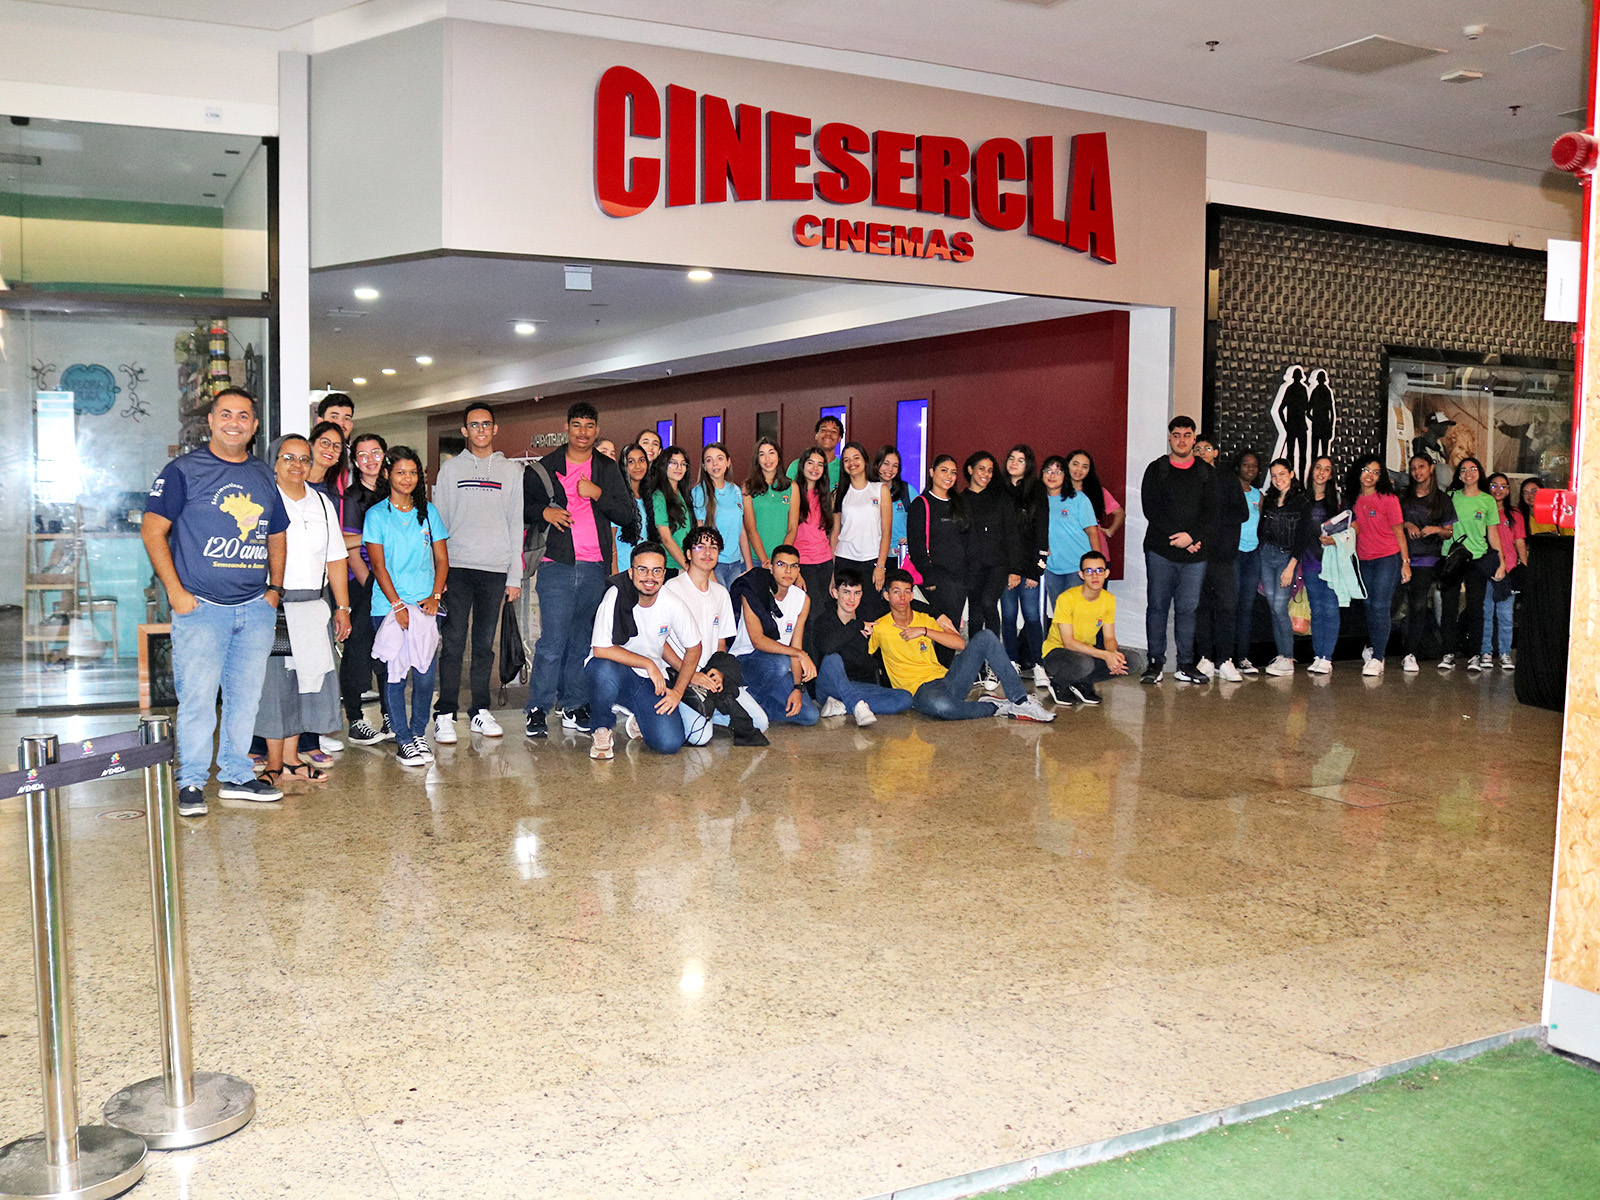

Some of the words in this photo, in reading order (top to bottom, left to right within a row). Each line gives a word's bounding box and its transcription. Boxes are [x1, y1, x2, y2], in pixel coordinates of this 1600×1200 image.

[595, 65, 1117, 264] CINESERCLA
[793, 214, 974, 262] CINEMAS
[203, 536, 240, 559] 120
[101, 766, 125, 777] AVENIDA
[17, 783, 44, 794] AVENIDA
